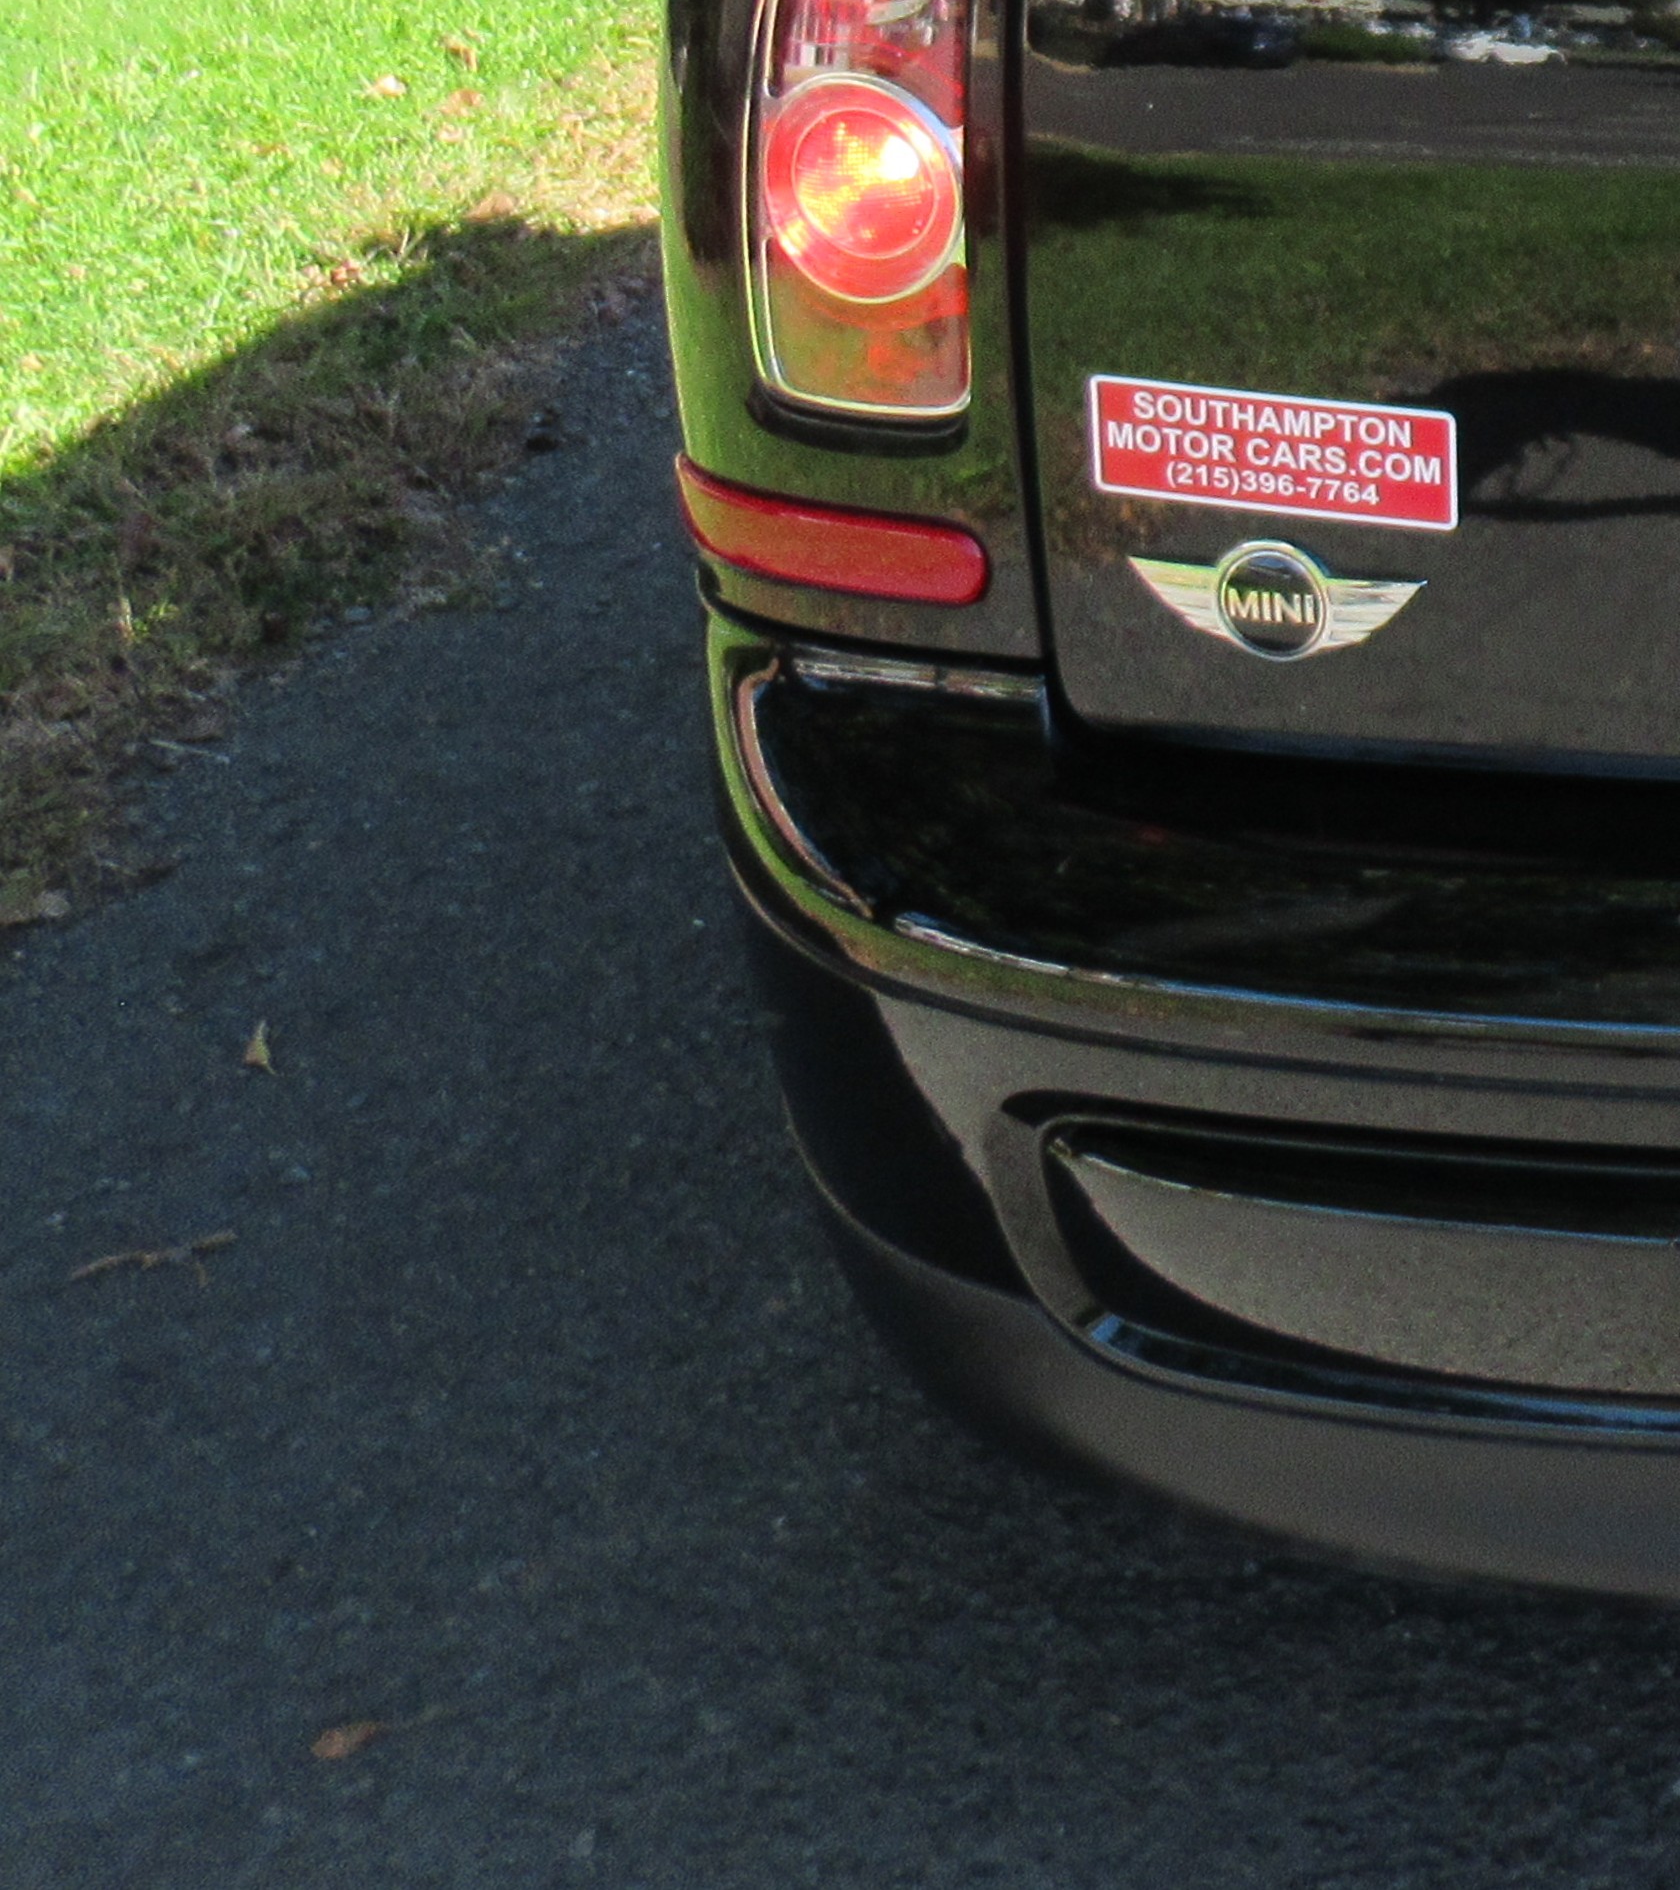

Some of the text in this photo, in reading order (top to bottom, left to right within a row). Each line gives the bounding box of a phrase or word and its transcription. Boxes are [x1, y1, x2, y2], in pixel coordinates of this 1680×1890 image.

[1132, 391, 1412, 448] SOUTHAMPTON
[1107, 421, 1442, 485] MOTOR CARS.COM
[1166, 461, 1380, 506] (215)396-7764
[1226, 588, 1319, 625] MINI
